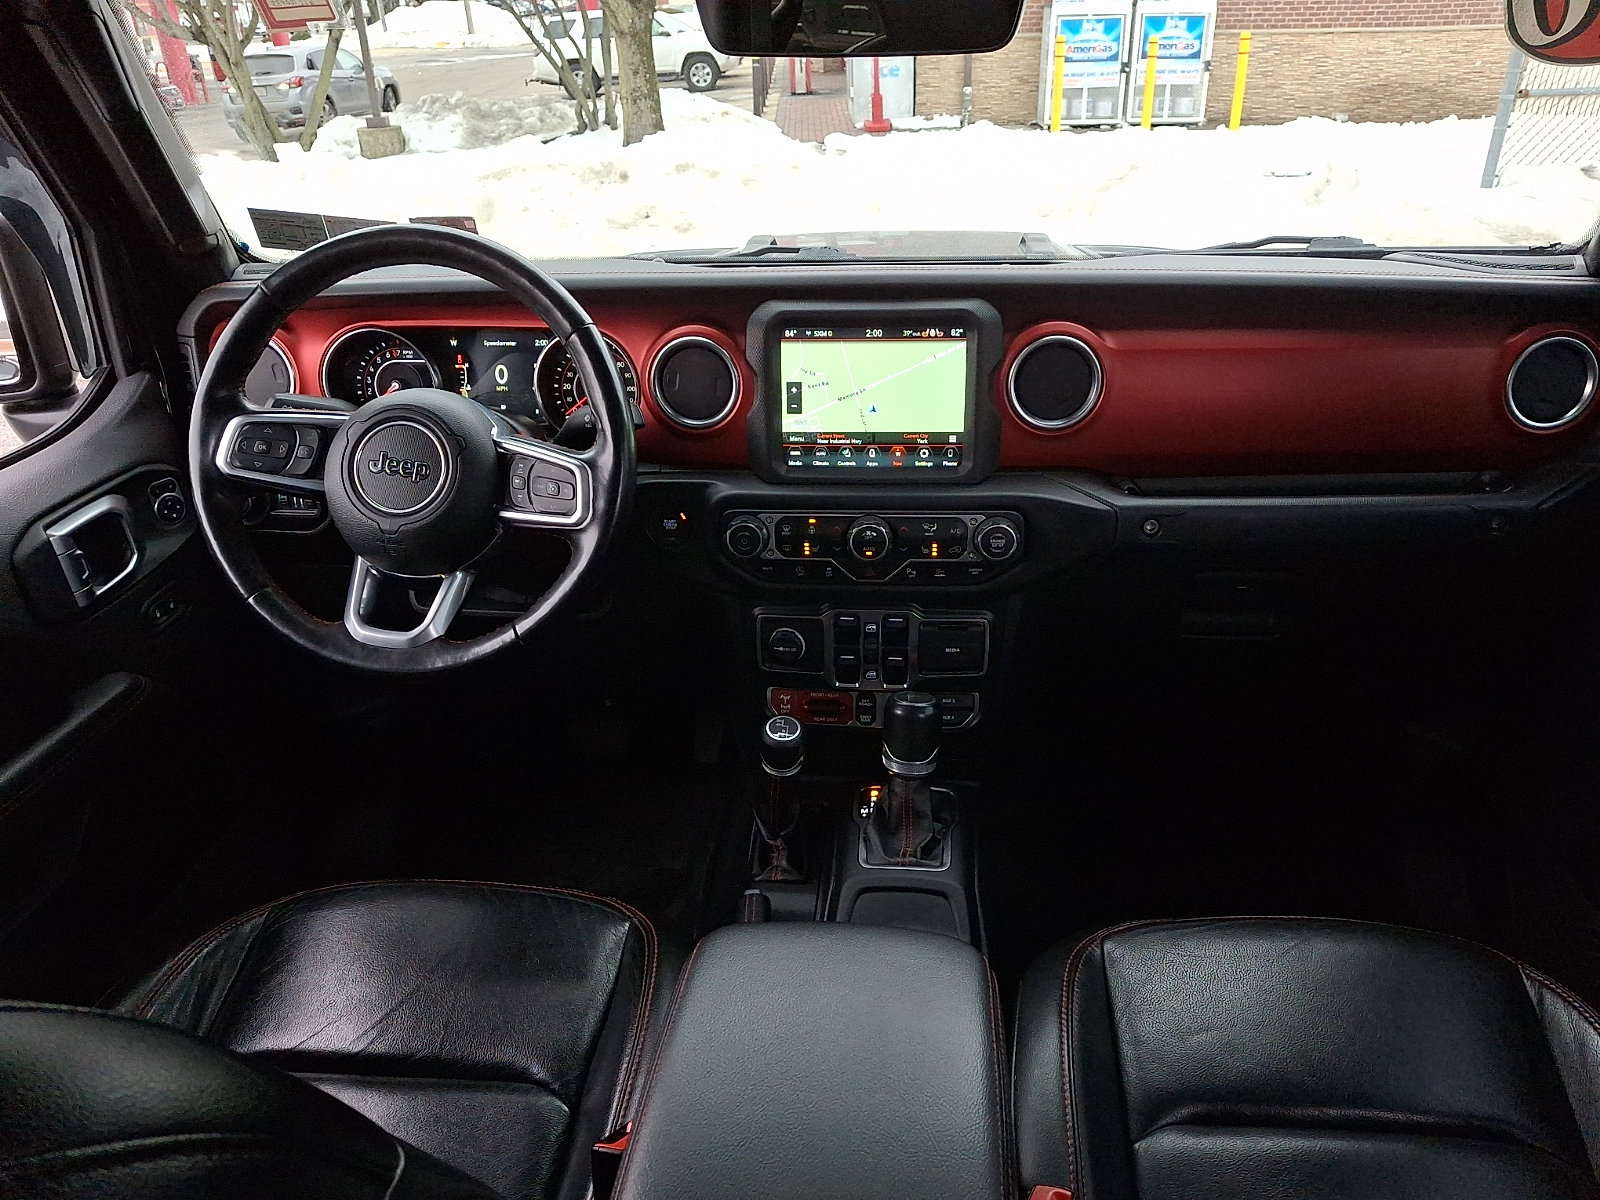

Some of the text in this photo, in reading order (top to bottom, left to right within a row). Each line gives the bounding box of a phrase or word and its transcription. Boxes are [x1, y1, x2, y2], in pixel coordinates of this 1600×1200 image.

[1066, 44, 1113, 54] AmeriGas
[865, 329, 883, 337] 2:00
[494, 364, 509, 384] 0
[368, 451, 431, 483] Jeep
